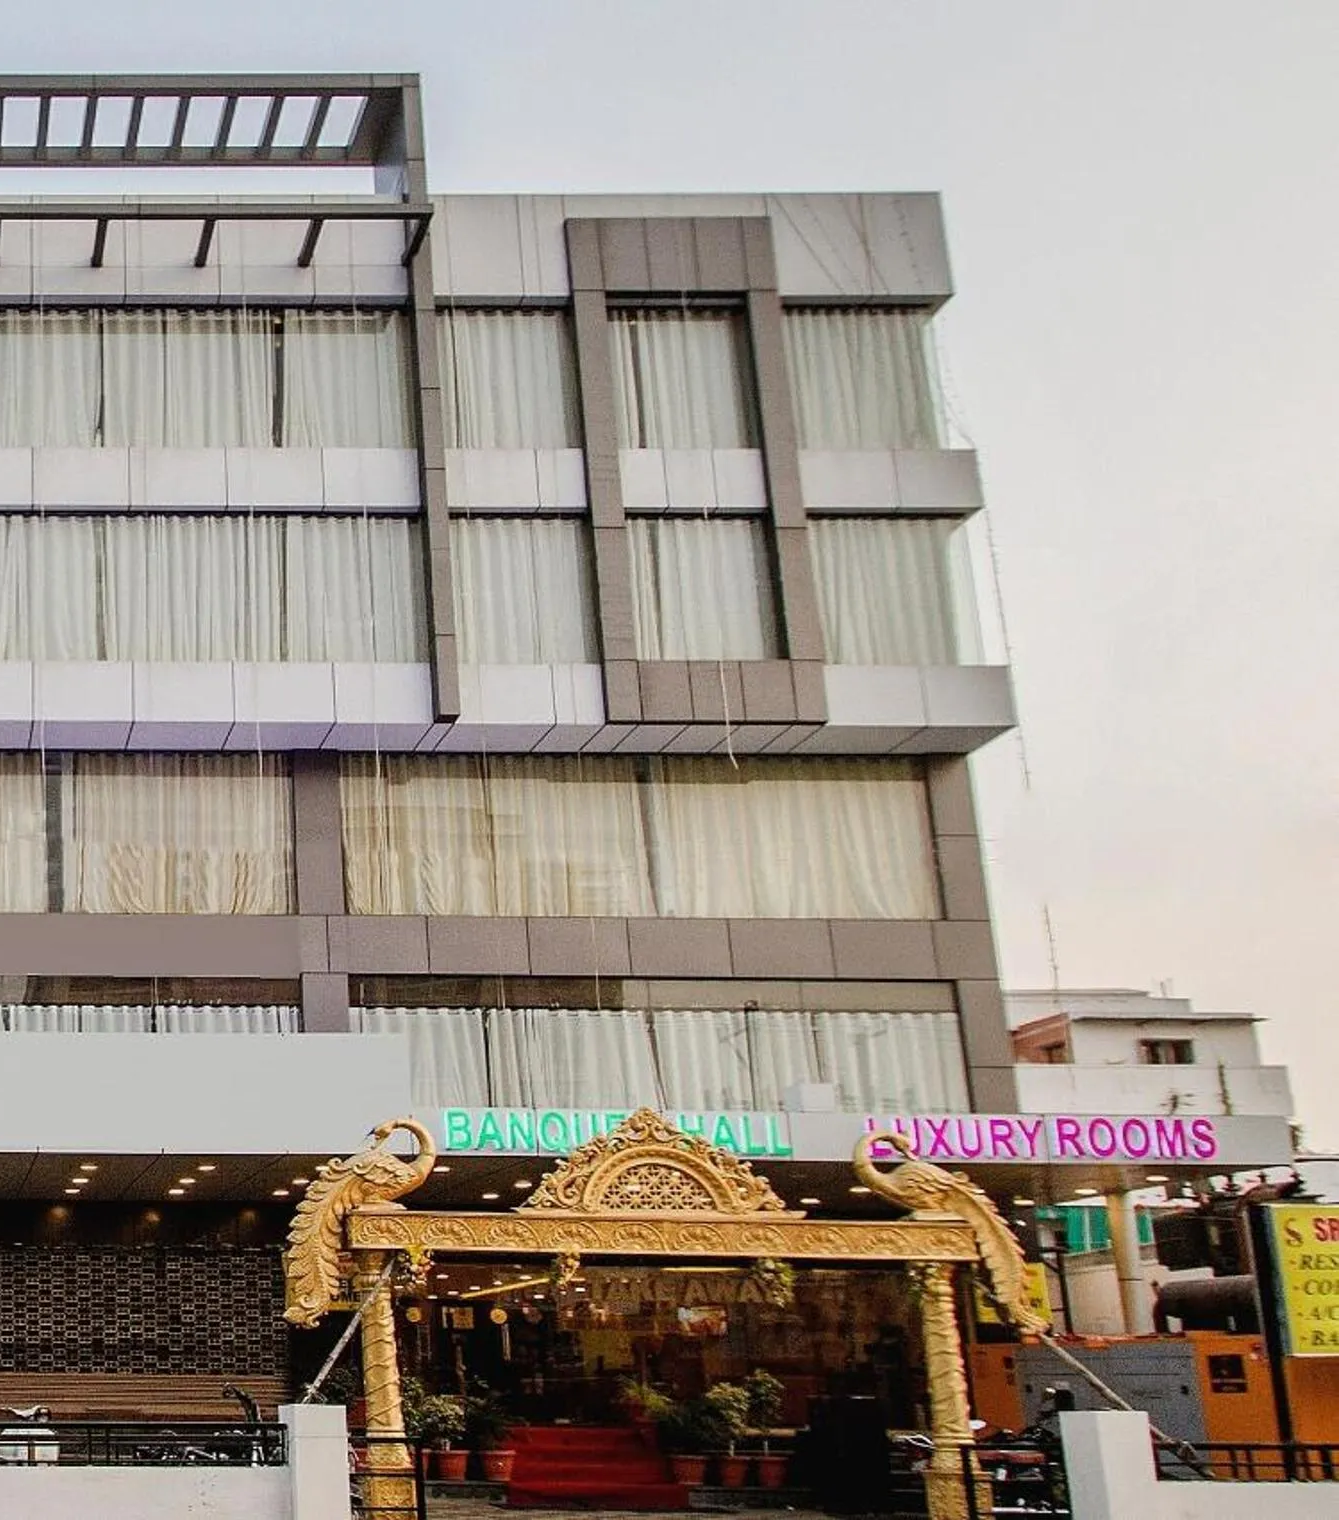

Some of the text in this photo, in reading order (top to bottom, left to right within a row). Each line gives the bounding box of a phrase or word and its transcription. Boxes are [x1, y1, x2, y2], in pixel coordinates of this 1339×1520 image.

[446, 1110, 792, 1156] BANQU HALL
[866, 1117, 1218, 1158] LUXURY ROOMS
